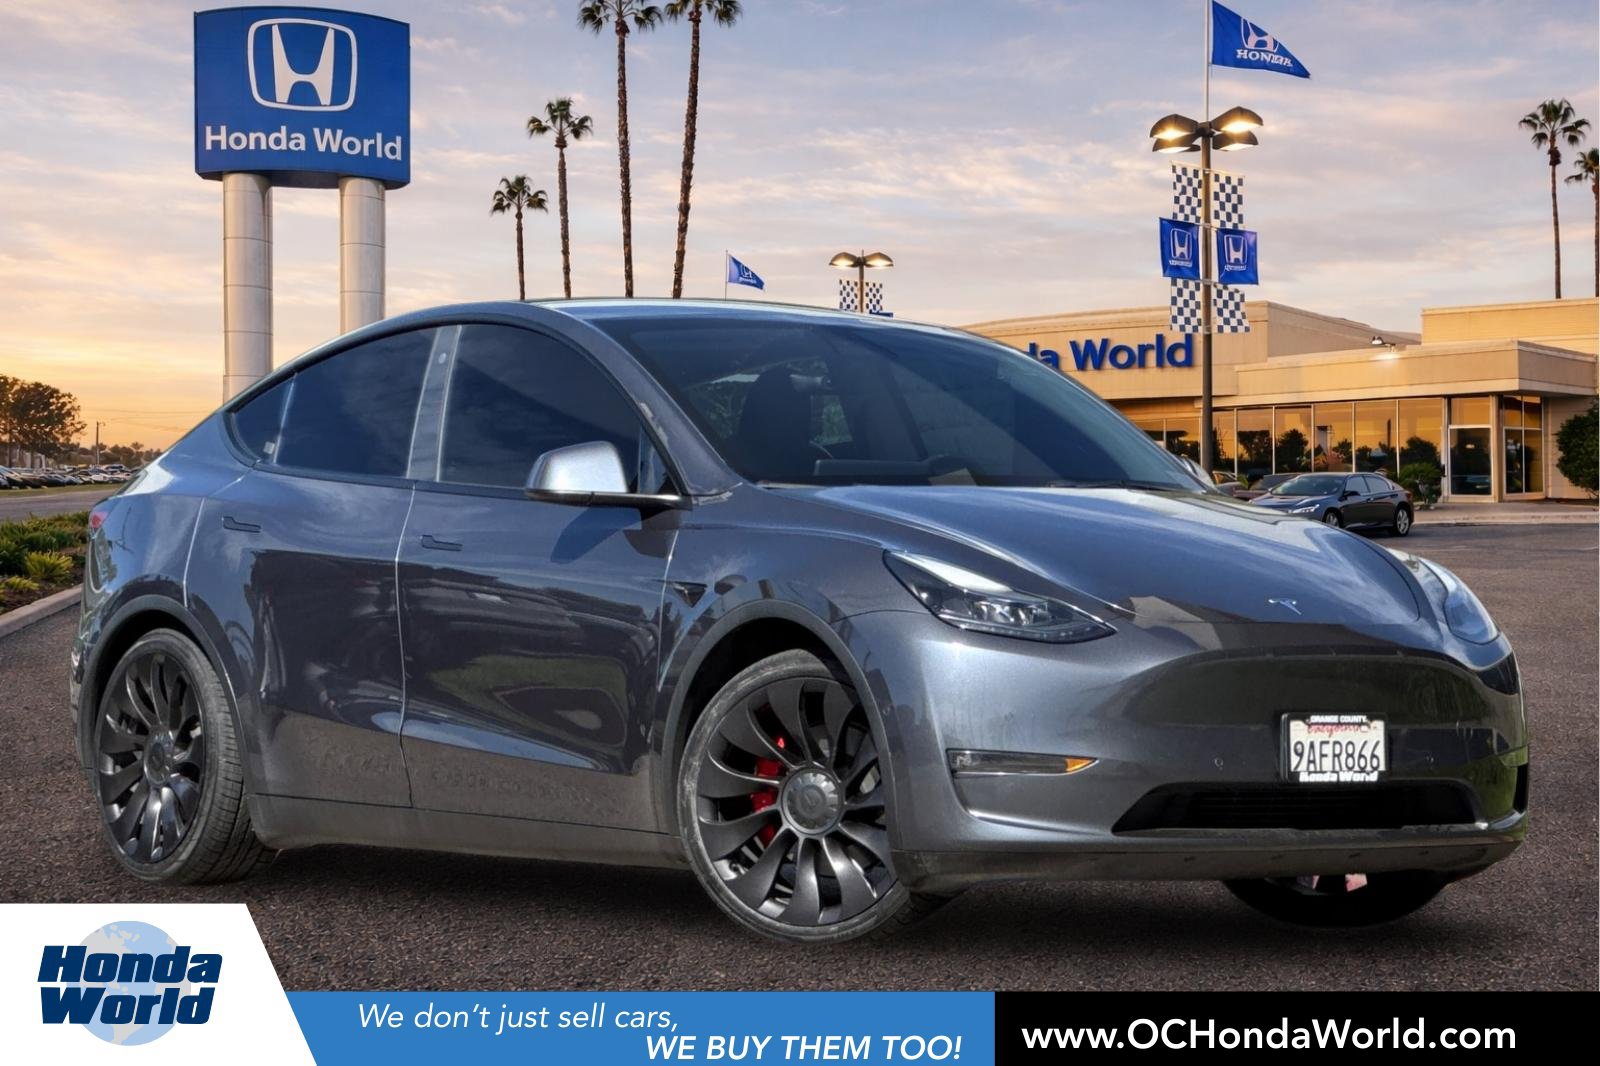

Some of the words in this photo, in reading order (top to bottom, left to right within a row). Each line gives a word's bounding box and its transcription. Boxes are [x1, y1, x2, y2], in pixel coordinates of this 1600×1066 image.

[205, 125, 306, 151] Honda
[313, 127, 403, 161] World
[1069, 333, 1193, 371] World
[1293, 740, 1381, 771] 9AFR866
[1299, 770, 1338, 782] Honda
[1339, 770, 1378, 782] World
